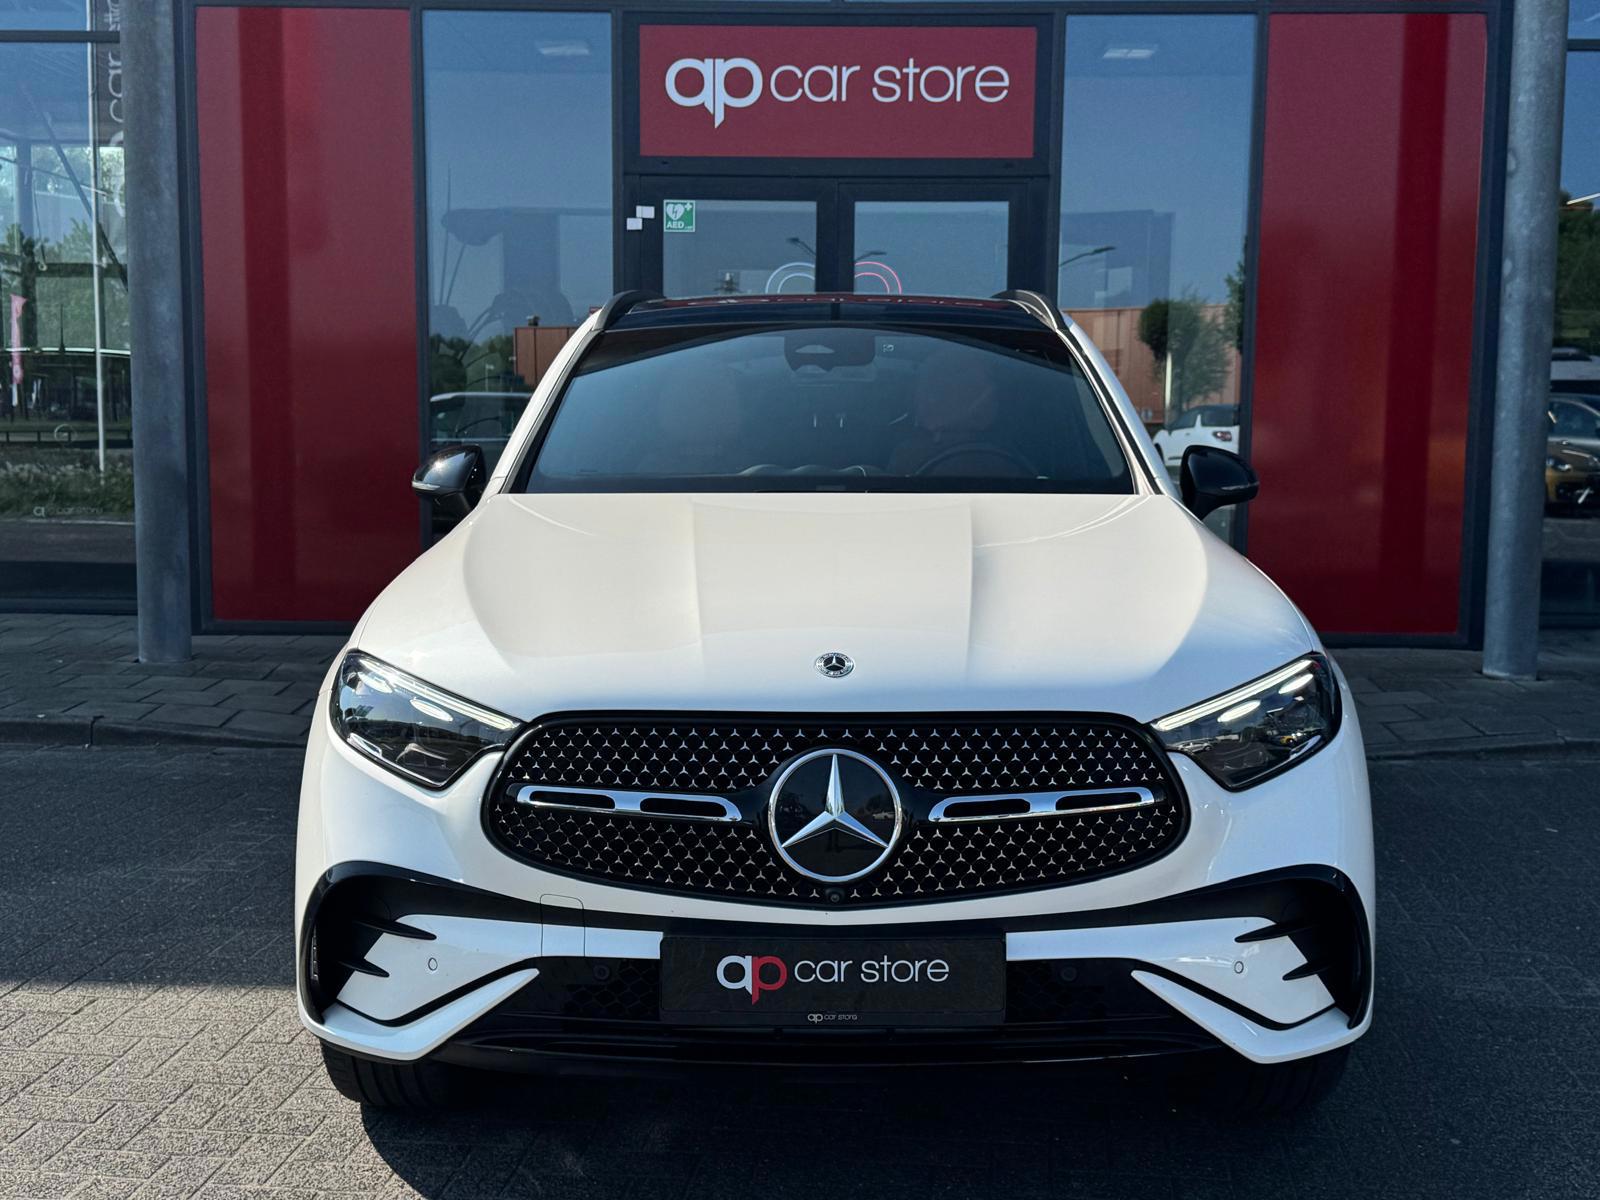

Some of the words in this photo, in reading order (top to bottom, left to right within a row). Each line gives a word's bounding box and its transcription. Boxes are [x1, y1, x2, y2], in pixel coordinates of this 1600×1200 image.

[770, 64, 861, 103] car
[873, 58, 1010, 103] store
[794, 959, 853, 983] car
[860, 955, 950, 983] store
